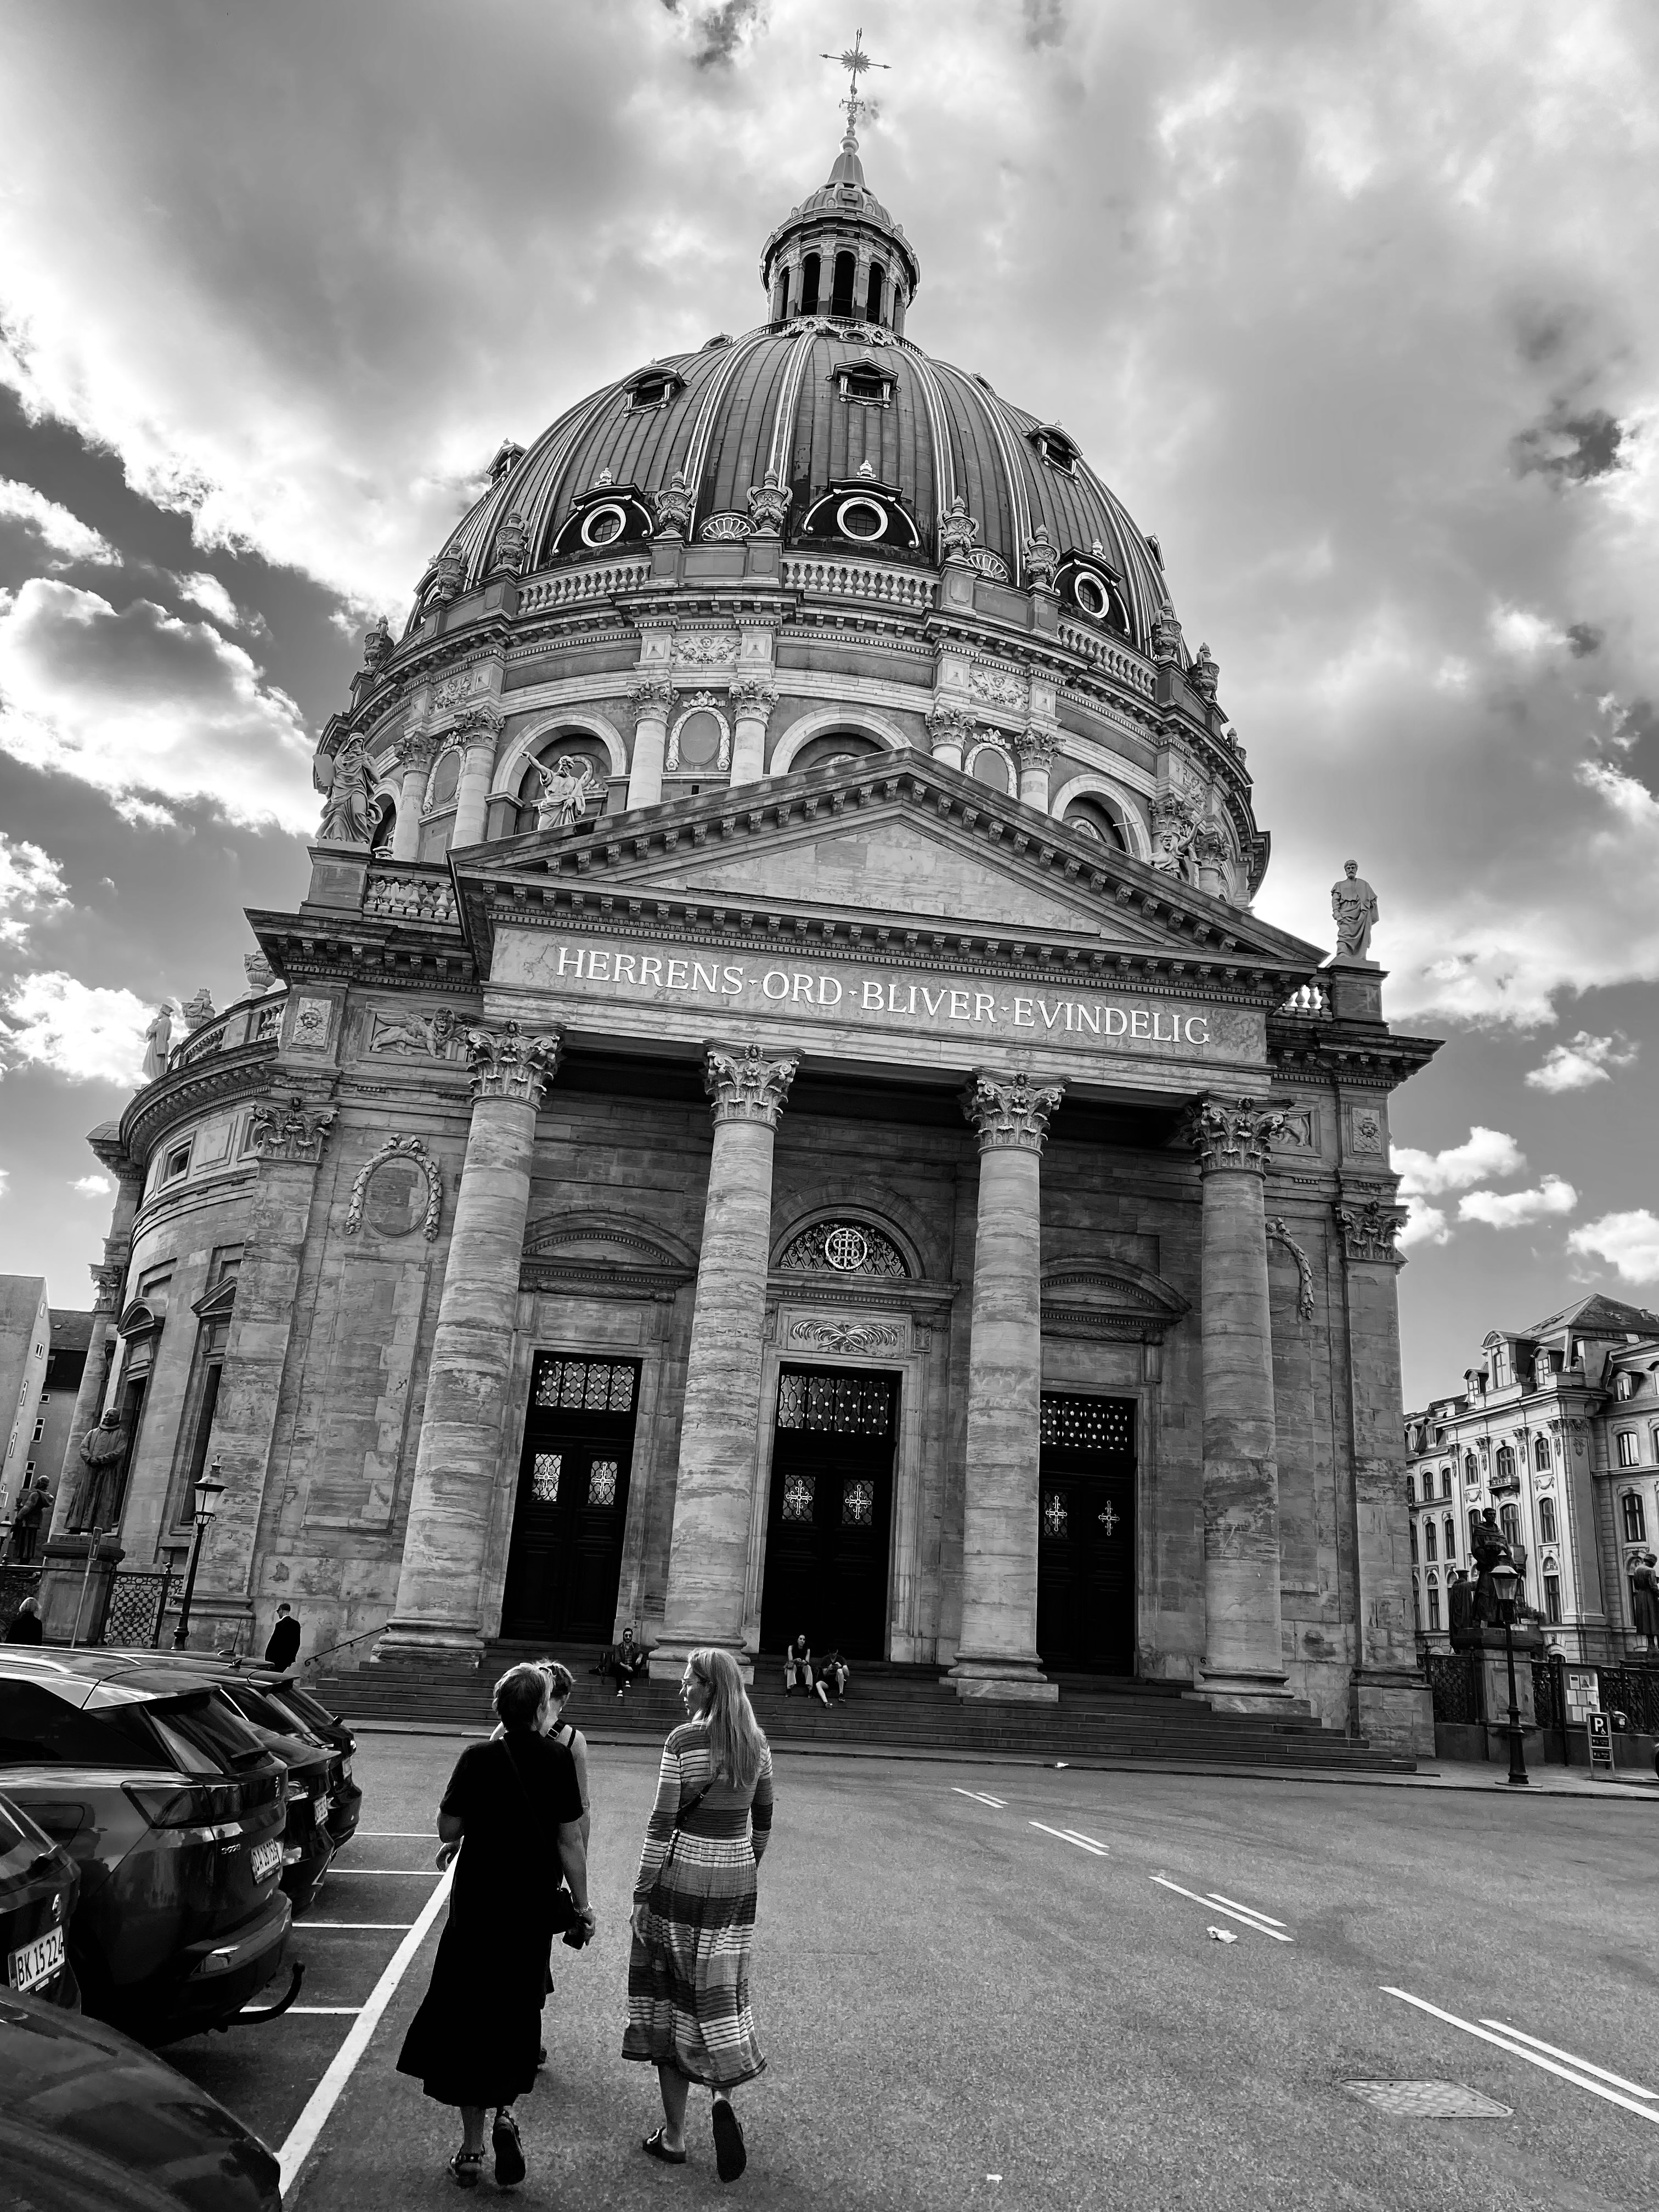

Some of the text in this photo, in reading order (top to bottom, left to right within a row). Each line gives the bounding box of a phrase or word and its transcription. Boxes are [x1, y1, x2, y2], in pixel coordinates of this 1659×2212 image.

[556, 947, 1210, 1045] HERRENS ORD BLIVER EVINDELIG
[1594, 1718, 1604, 1731] P
[18, 1951, 32, 1985] BK
[34, 1943, 45, 1976] 15
[46, 1931, 64, 1967] 224
